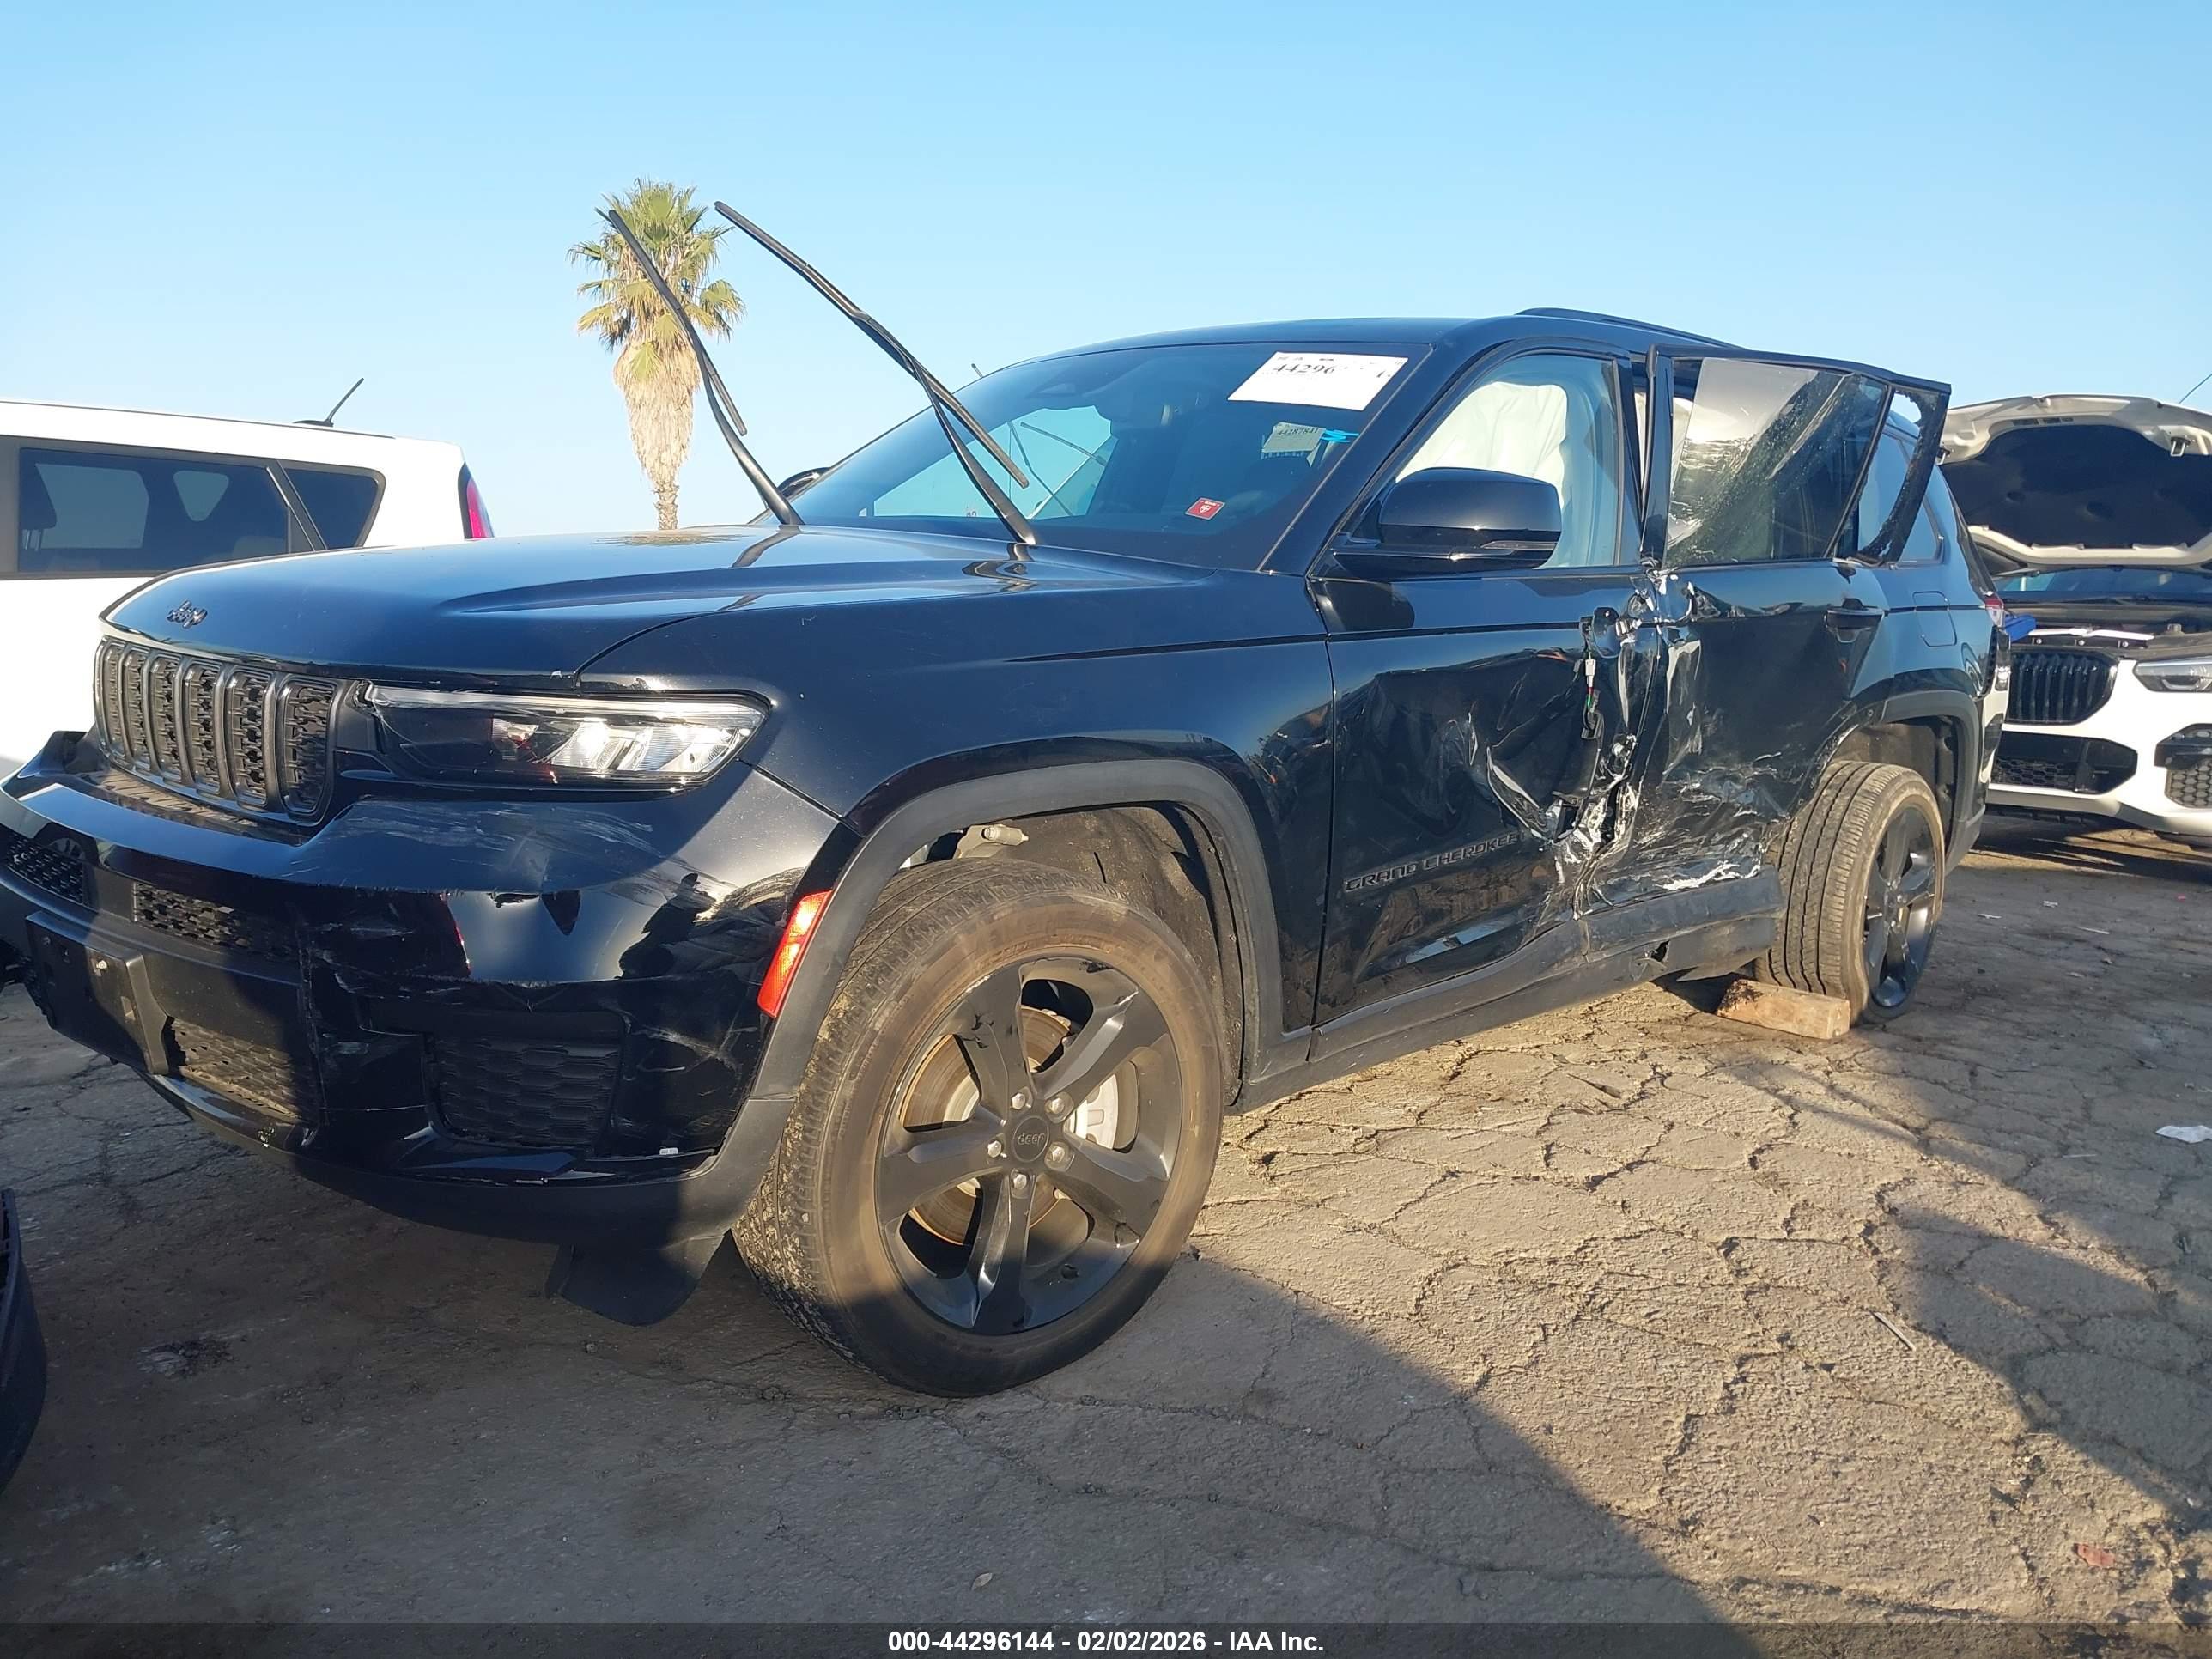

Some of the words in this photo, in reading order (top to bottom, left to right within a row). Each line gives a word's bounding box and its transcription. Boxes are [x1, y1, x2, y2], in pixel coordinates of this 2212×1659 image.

[166, 599, 208, 629] Jeep
[1344, 861, 1418, 892] GRAND
[1422, 830, 1518, 871] CHEROKEE
